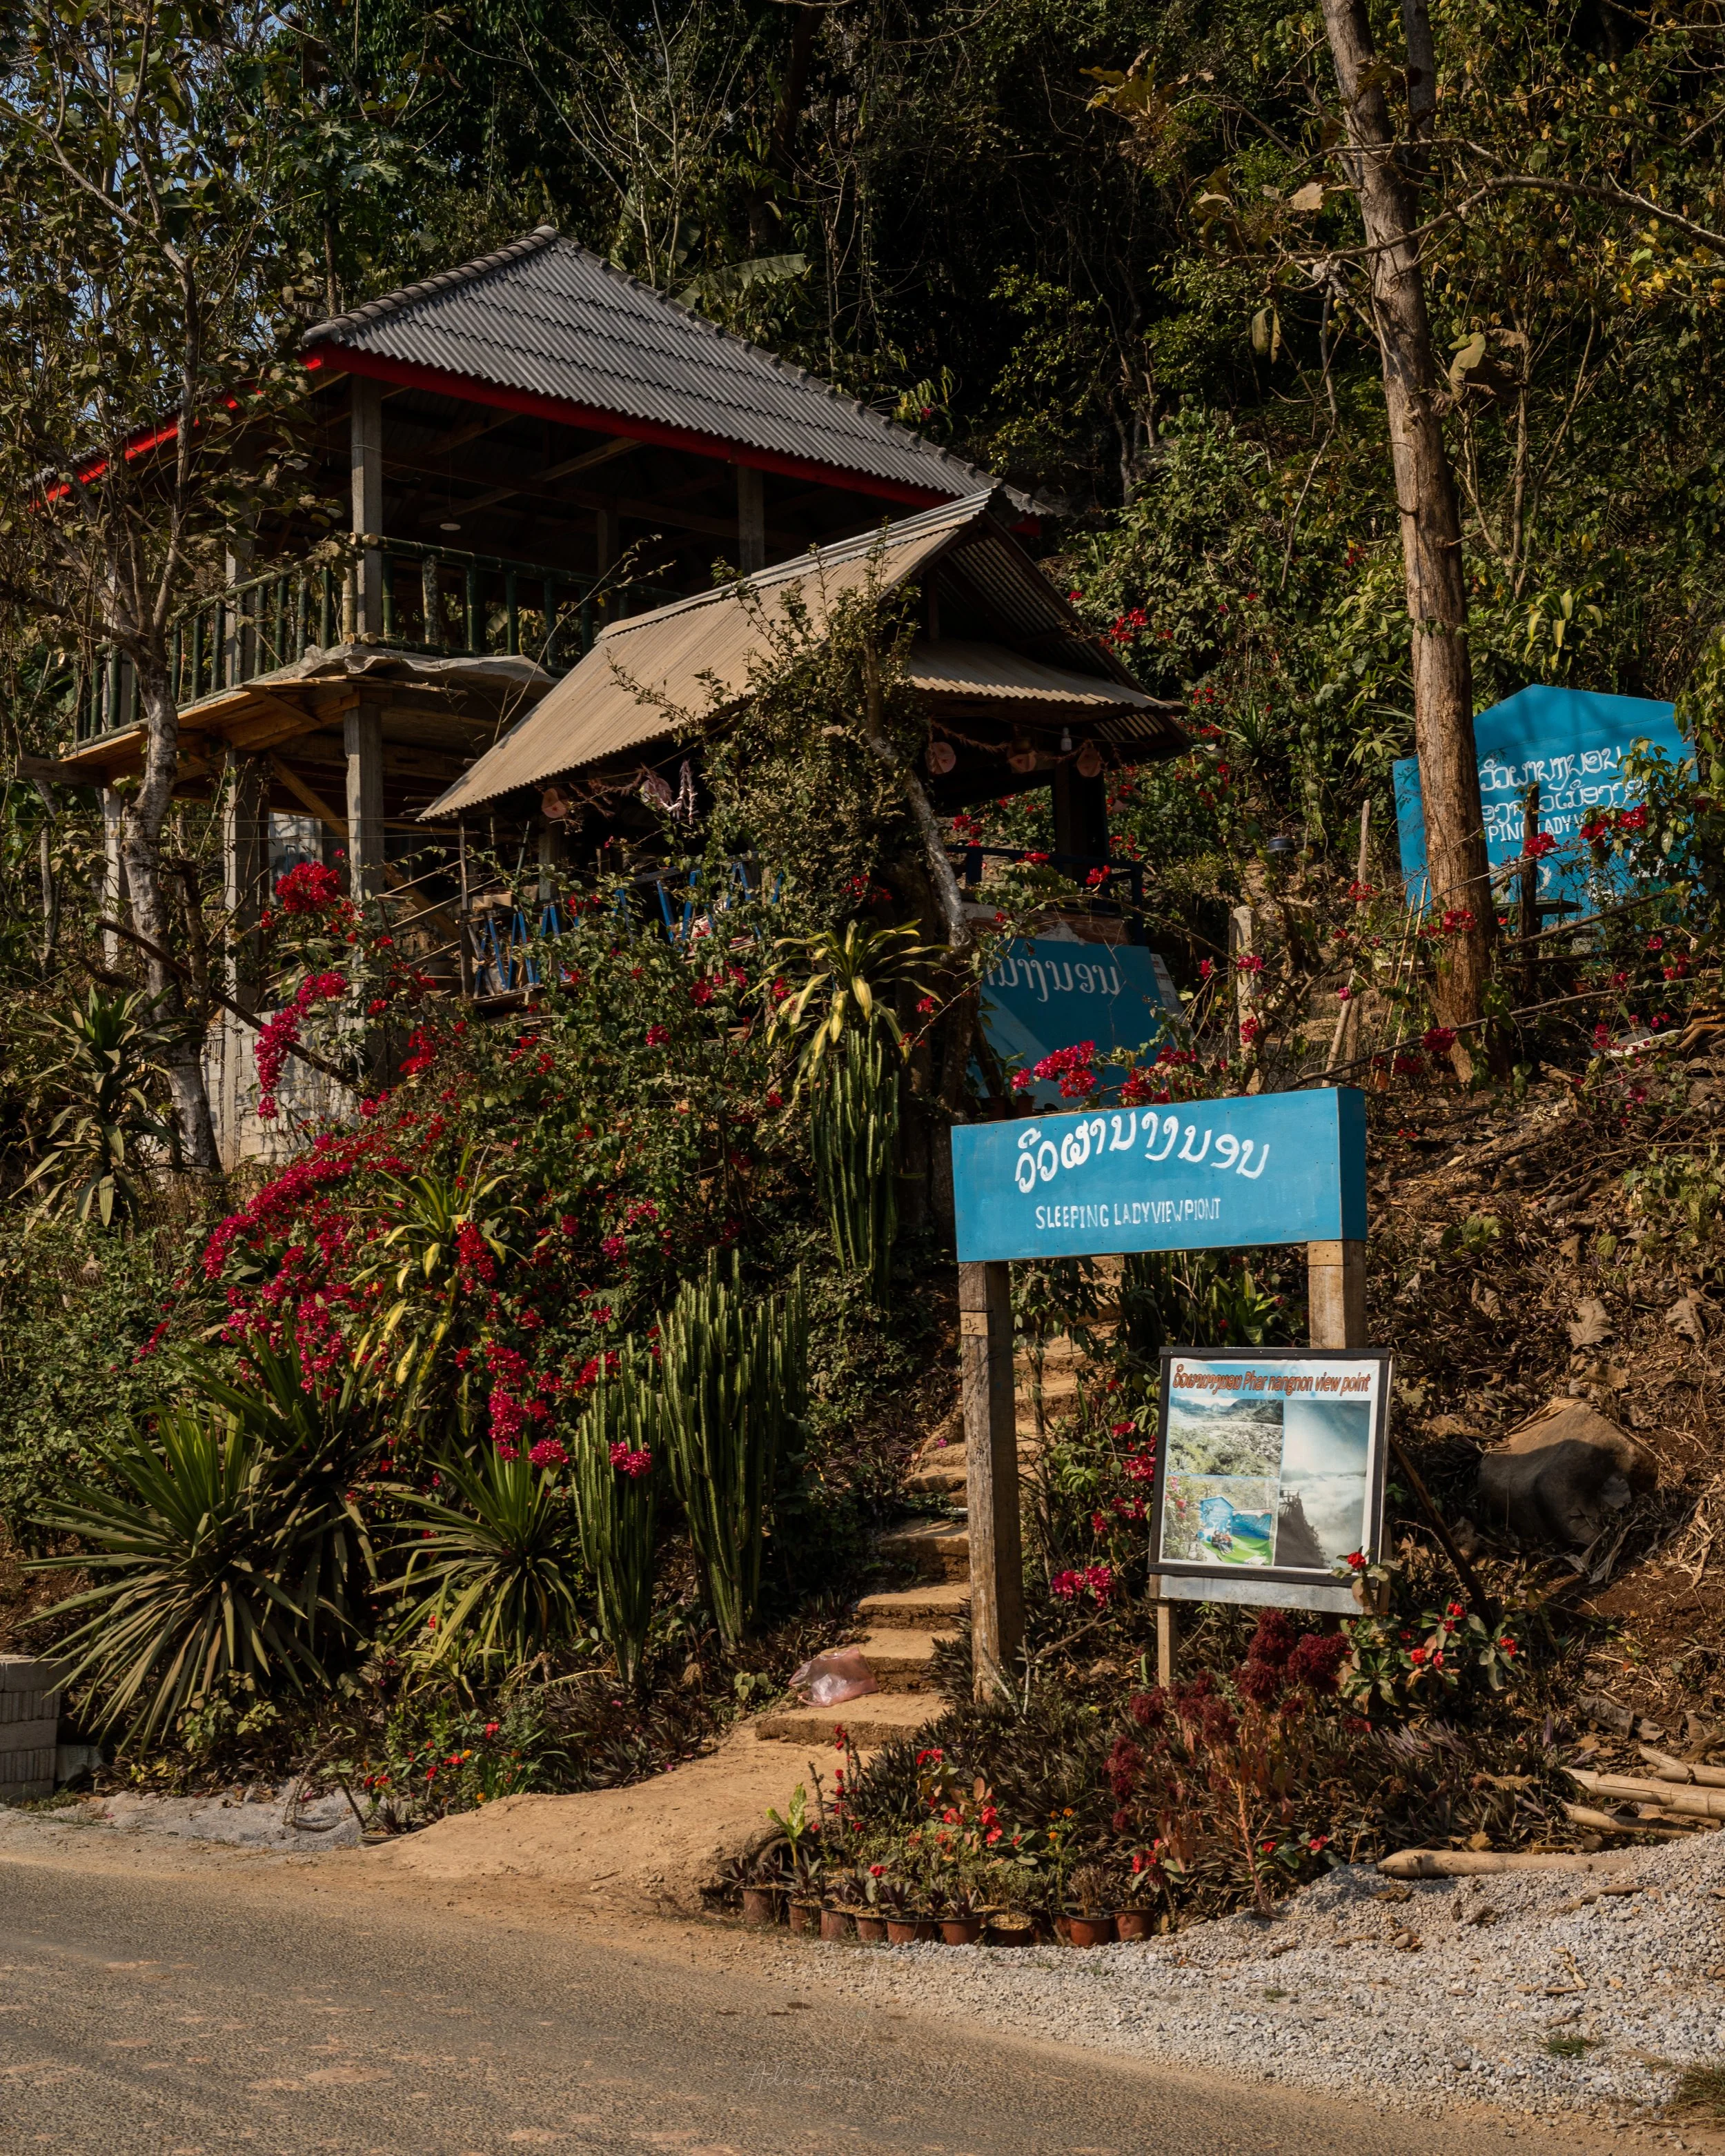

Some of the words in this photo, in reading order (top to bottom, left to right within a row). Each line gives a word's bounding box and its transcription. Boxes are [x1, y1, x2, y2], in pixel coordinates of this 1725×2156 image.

[1036, 1204, 1109, 1229] SLEEPING
[1242, 1370, 1268, 1391] Phar
[1268, 1375, 1314, 1396] nangnon
[1314, 1372, 1341, 1392] view
[1339, 1372, 1371, 1396] point
